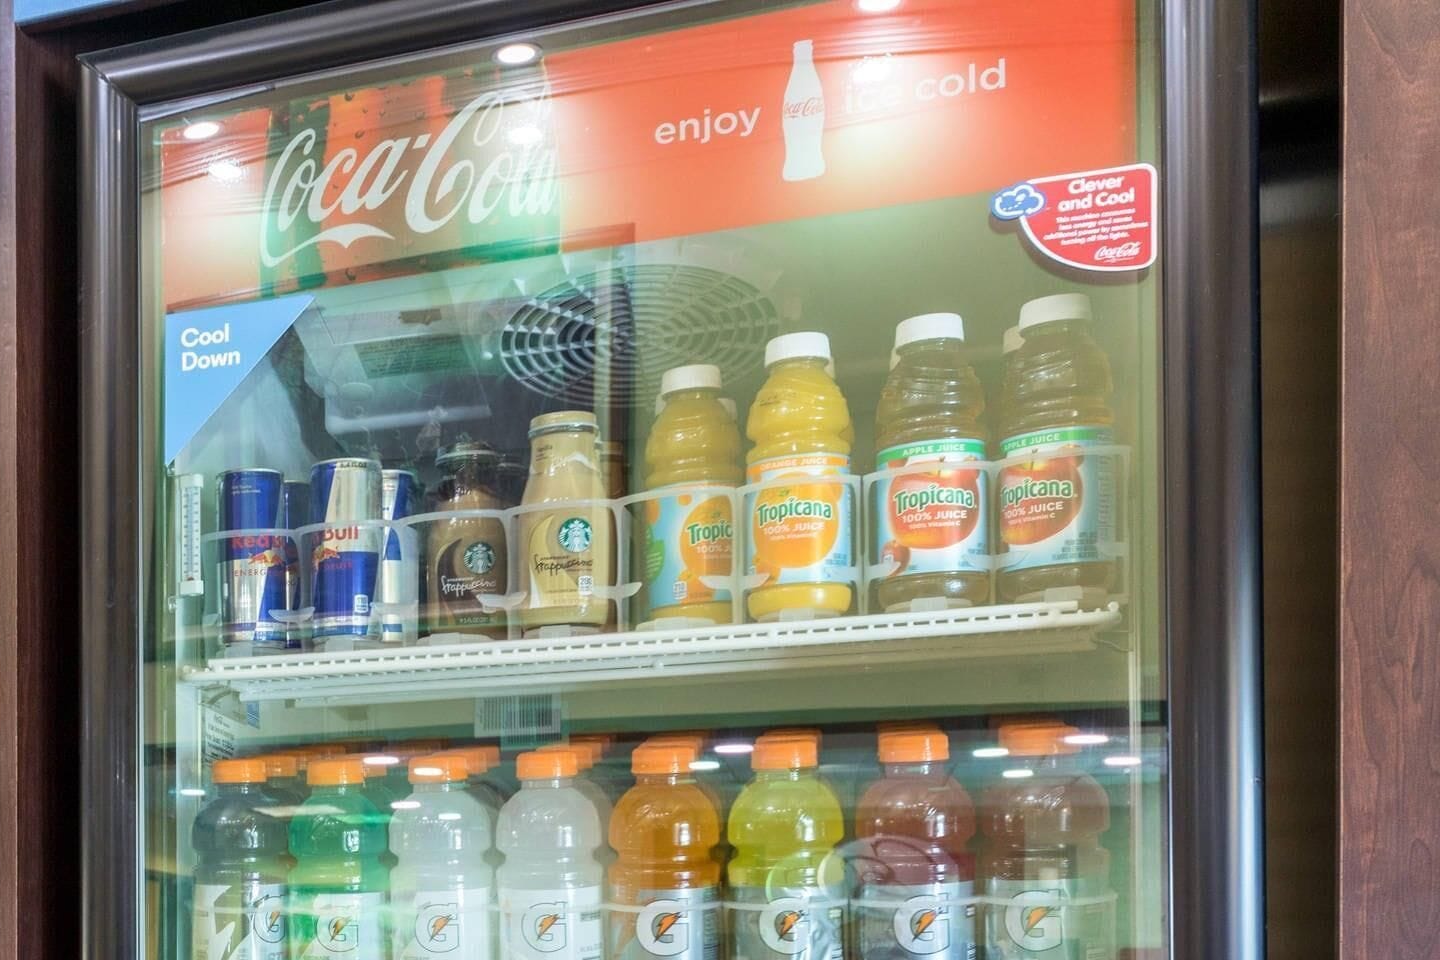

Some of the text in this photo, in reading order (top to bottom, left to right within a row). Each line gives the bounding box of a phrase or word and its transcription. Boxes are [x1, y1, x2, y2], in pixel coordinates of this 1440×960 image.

[915, 58, 1007, 101] cold
[654, 107, 762, 146] enjoy
[1068, 176, 1125, 195] Clever
[1058, 187, 1136, 212] and Cool
[1094, 242, 1142, 262] Coca-Cola
[181, 323, 230, 348] Cool
[181, 348, 241, 371] Down
[902, 442, 967, 457] APPLE JUICE
[1003, 432, 1061, 451] APPLE JUICE
[799, 456, 828, 466] JUICE
[894, 484, 976, 516] Tropicana
[1028, 501, 1065, 513] JUICE
[757, 497, 832, 527] Tropicana
[902, 508, 968, 524] 100% JUICE
[686, 520, 733, 544] Tropic
[763, 521, 825, 536] 100% JUICE
